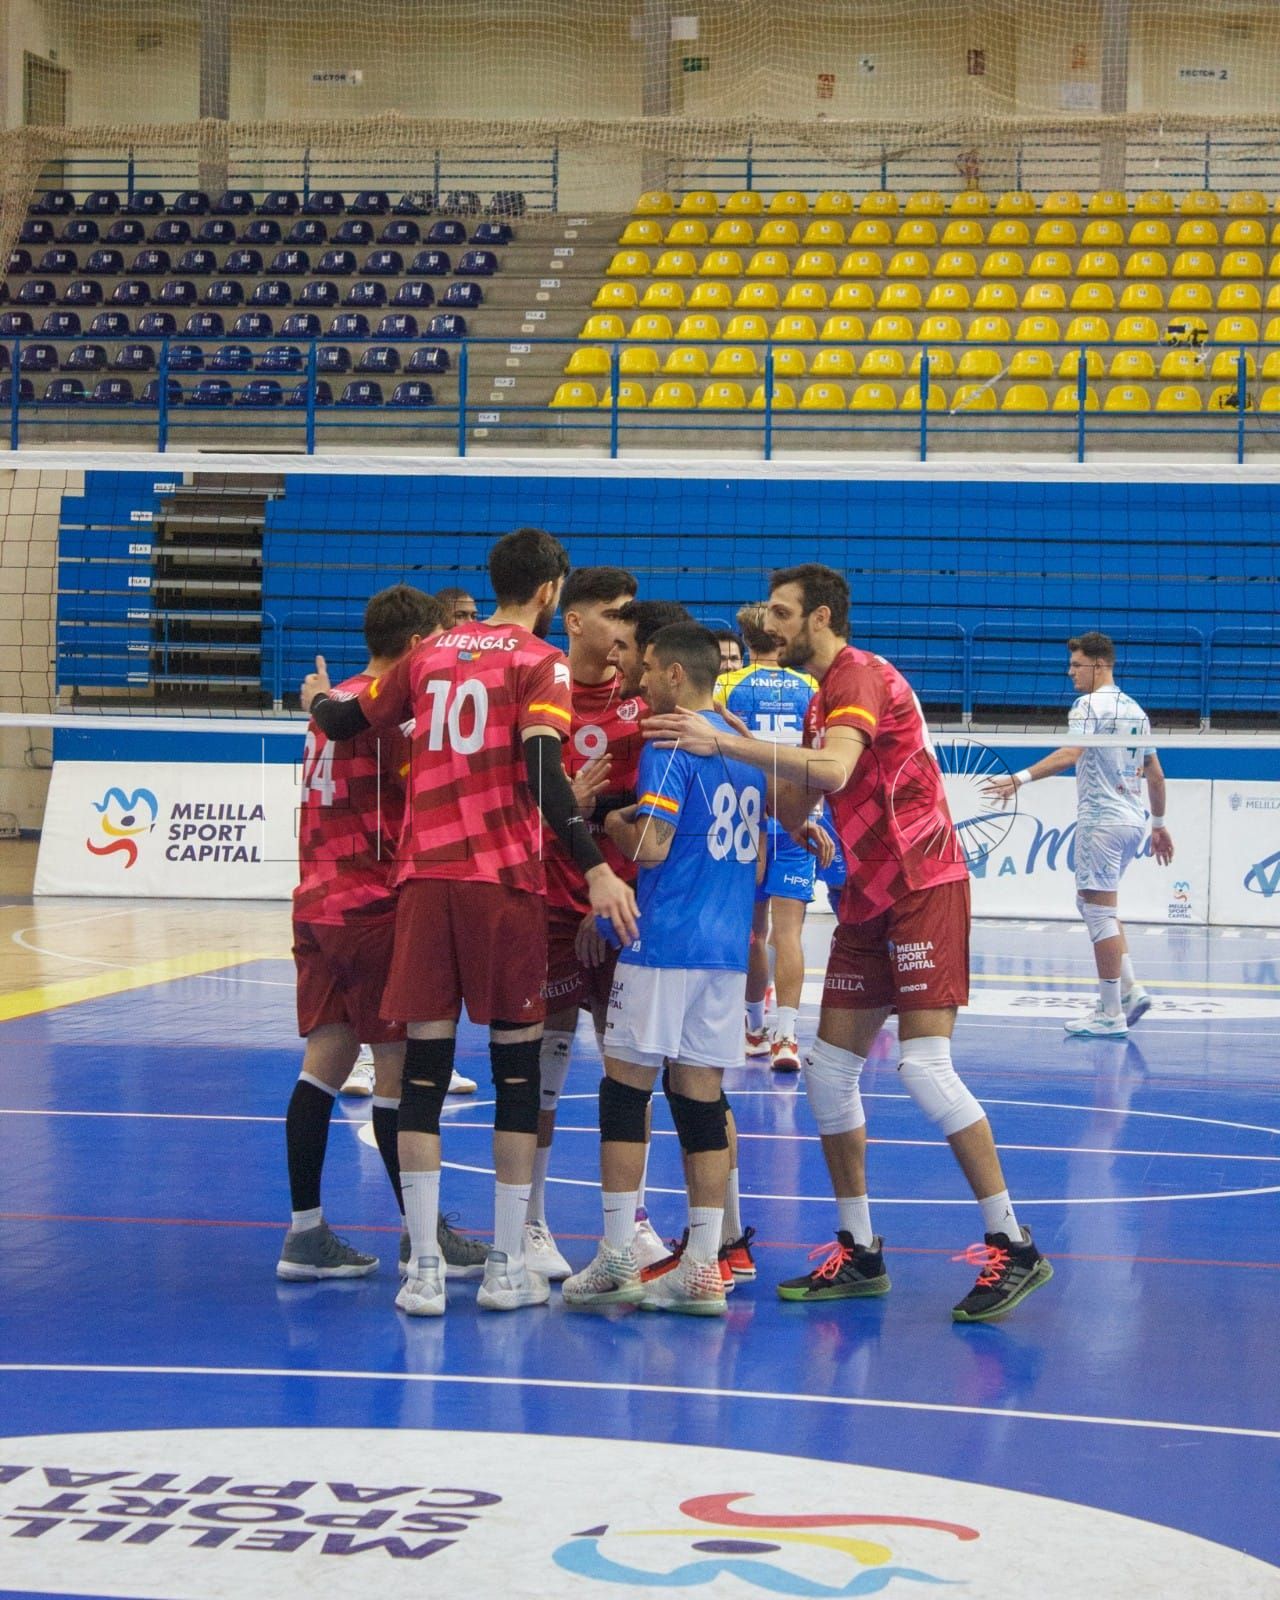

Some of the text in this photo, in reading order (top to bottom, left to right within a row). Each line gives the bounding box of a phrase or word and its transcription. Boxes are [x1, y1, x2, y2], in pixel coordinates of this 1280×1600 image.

[435, 634, 518, 651] LUENGAS
[751, 677, 800, 689] KNIGGE
[425, 678, 489, 755] 10
[574, 724, 608, 774] 9
[170, 803, 266, 821] MELILLA
[707, 782, 760, 864] 88
[168, 824, 246, 842] SPORT
[165, 845, 262, 863] CAPITAL
[896, 941, 934, 954] MELILLA
[897, 951, 928, 963] SPORT
[898, 960, 936, 972] CAPITAL
[825, 978, 865, 991] ELILLA
[14, 1493, 483, 1533] SPORT
[0, 1514, 459, 1560] MELILL
